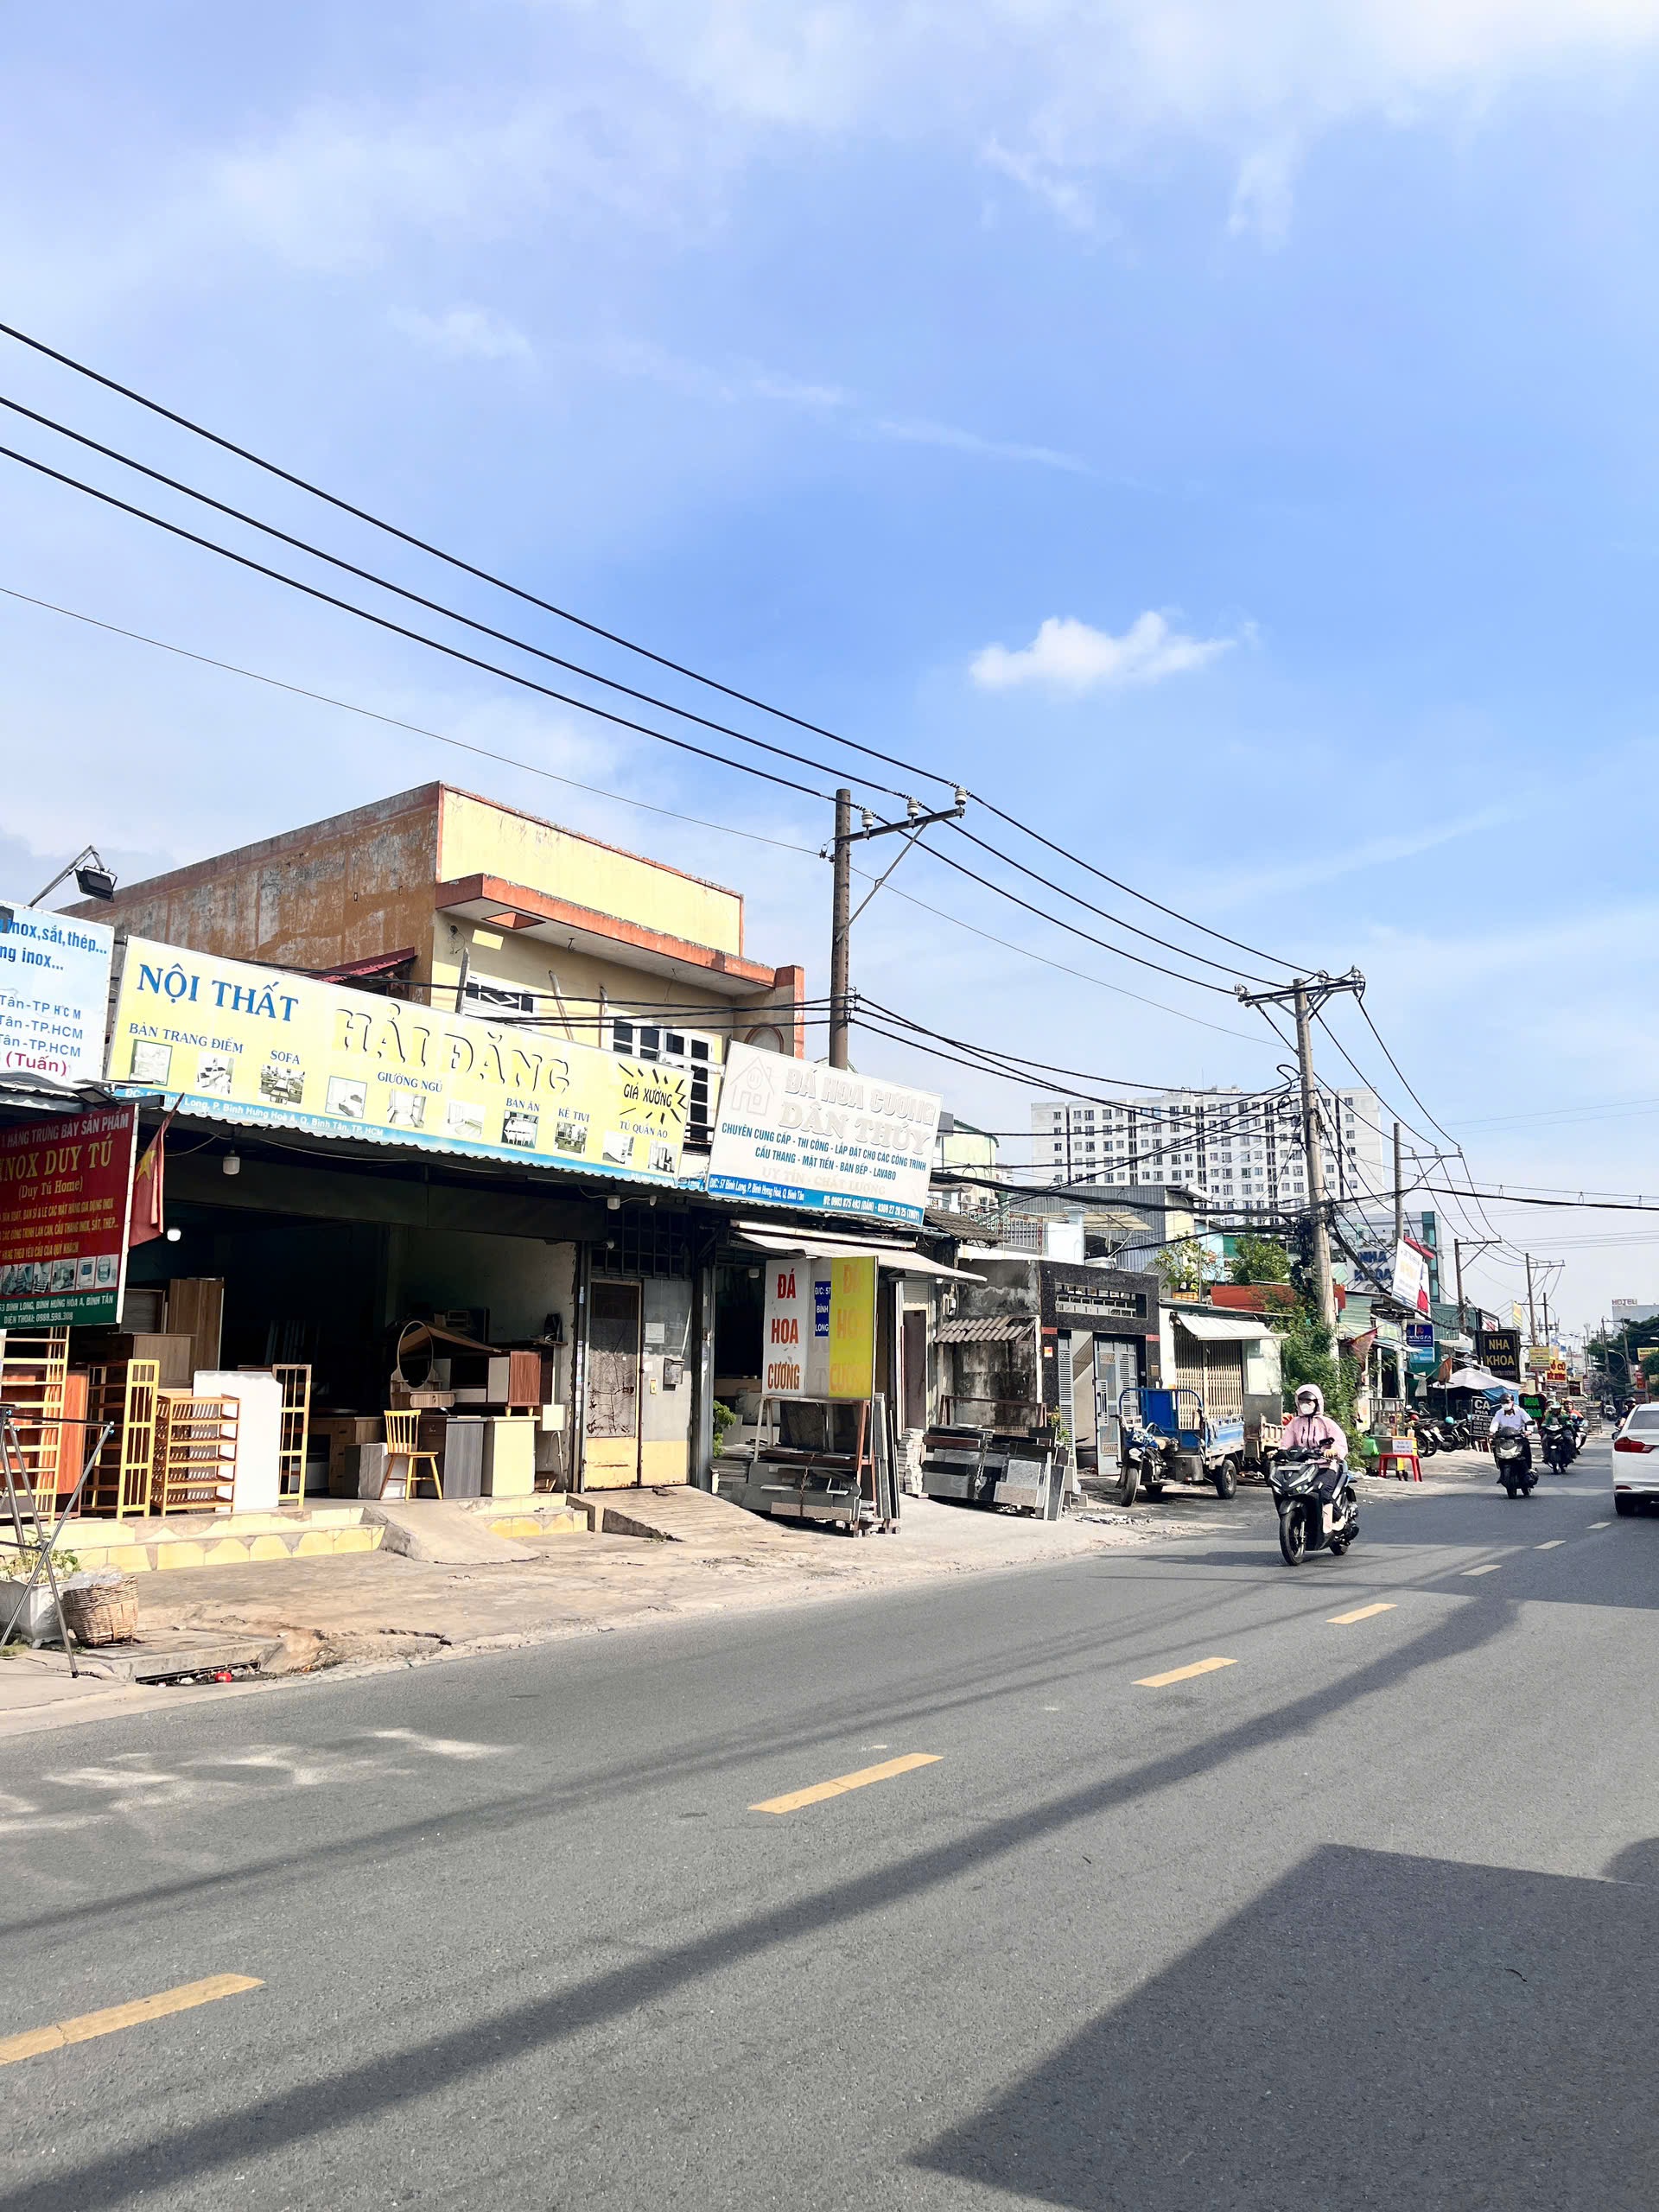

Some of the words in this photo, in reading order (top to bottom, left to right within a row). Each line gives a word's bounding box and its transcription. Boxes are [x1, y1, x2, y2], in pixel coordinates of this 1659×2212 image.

[22, 947, 64, 971] inox...
[137, 963, 200, 1004] NỘI
[212, 980, 299, 1021] THẤT
[129, 1022, 158, 1038] BÀN
[162, 1028, 207, 1047] TRANG
[211, 1037, 245, 1054] ĐIỂM
[331, 1002, 430, 1068] HẢI
[6, 1051, 67, 1077] (Tuấn)
[270, 1050, 300, 1065] SOFA
[377, 1071, 418, 1088] GIƯỜNG
[421, 1079, 443, 1093] NGỦ
[821, 1076, 864, 1110] HOA
[505, 1096, 525, 1110] BÀN
[623, 1082, 639, 1100] GIÁ
[642, 1086, 673, 1109] XƯỞNG
[80, 1114, 99, 1135] SẢN
[102, 1107, 130, 1131] PHẨM
[573, 1109, 590, 1123] TIVI
[365, 1126, 384, 1136] HCM
[44, 1145, 83, 1176] DUY
[88, 1133, 113, 1169] TÚ
[721, 1122, 753, 1138] CHUYÊN
[753, 1128, 775, 1142] CUNG
[776, 1131, 791, 1145] CẤP
[798, 1137, 810, 1148] THI
[810, 1139, 830, 1153] CÔNG
[862, 1149, 876, 1160] CHO
[877, 1151, 890, 1163] CÁC
[891, 1154, 908, 1167] CÔNG
[909, 1158, 927, 1172] TRÌNH
[772, 1149, 796, 1164] THANG
[873, 1167, 897, 1181] LAVABO
[18, 1184, 38, 1200] (Duy
[41, 1181, 52, 1196] Tú
[54, 1175, 83, 1194] Home)
[777, 1268, 797, 1299] ĐÁ
[825, 1287, 831, 1295] 57
[816, 1302, 829, 1313] BÌNH
[771, 1318, 799, 1344] HOA
[815, 1323, 830, 1332] LONG
[1488, 1339, 1510, 1351] NHA
[1486, 1355, 1515, 1365] KHOA
[767, 1360, 800, 1390] CƯƠNG
